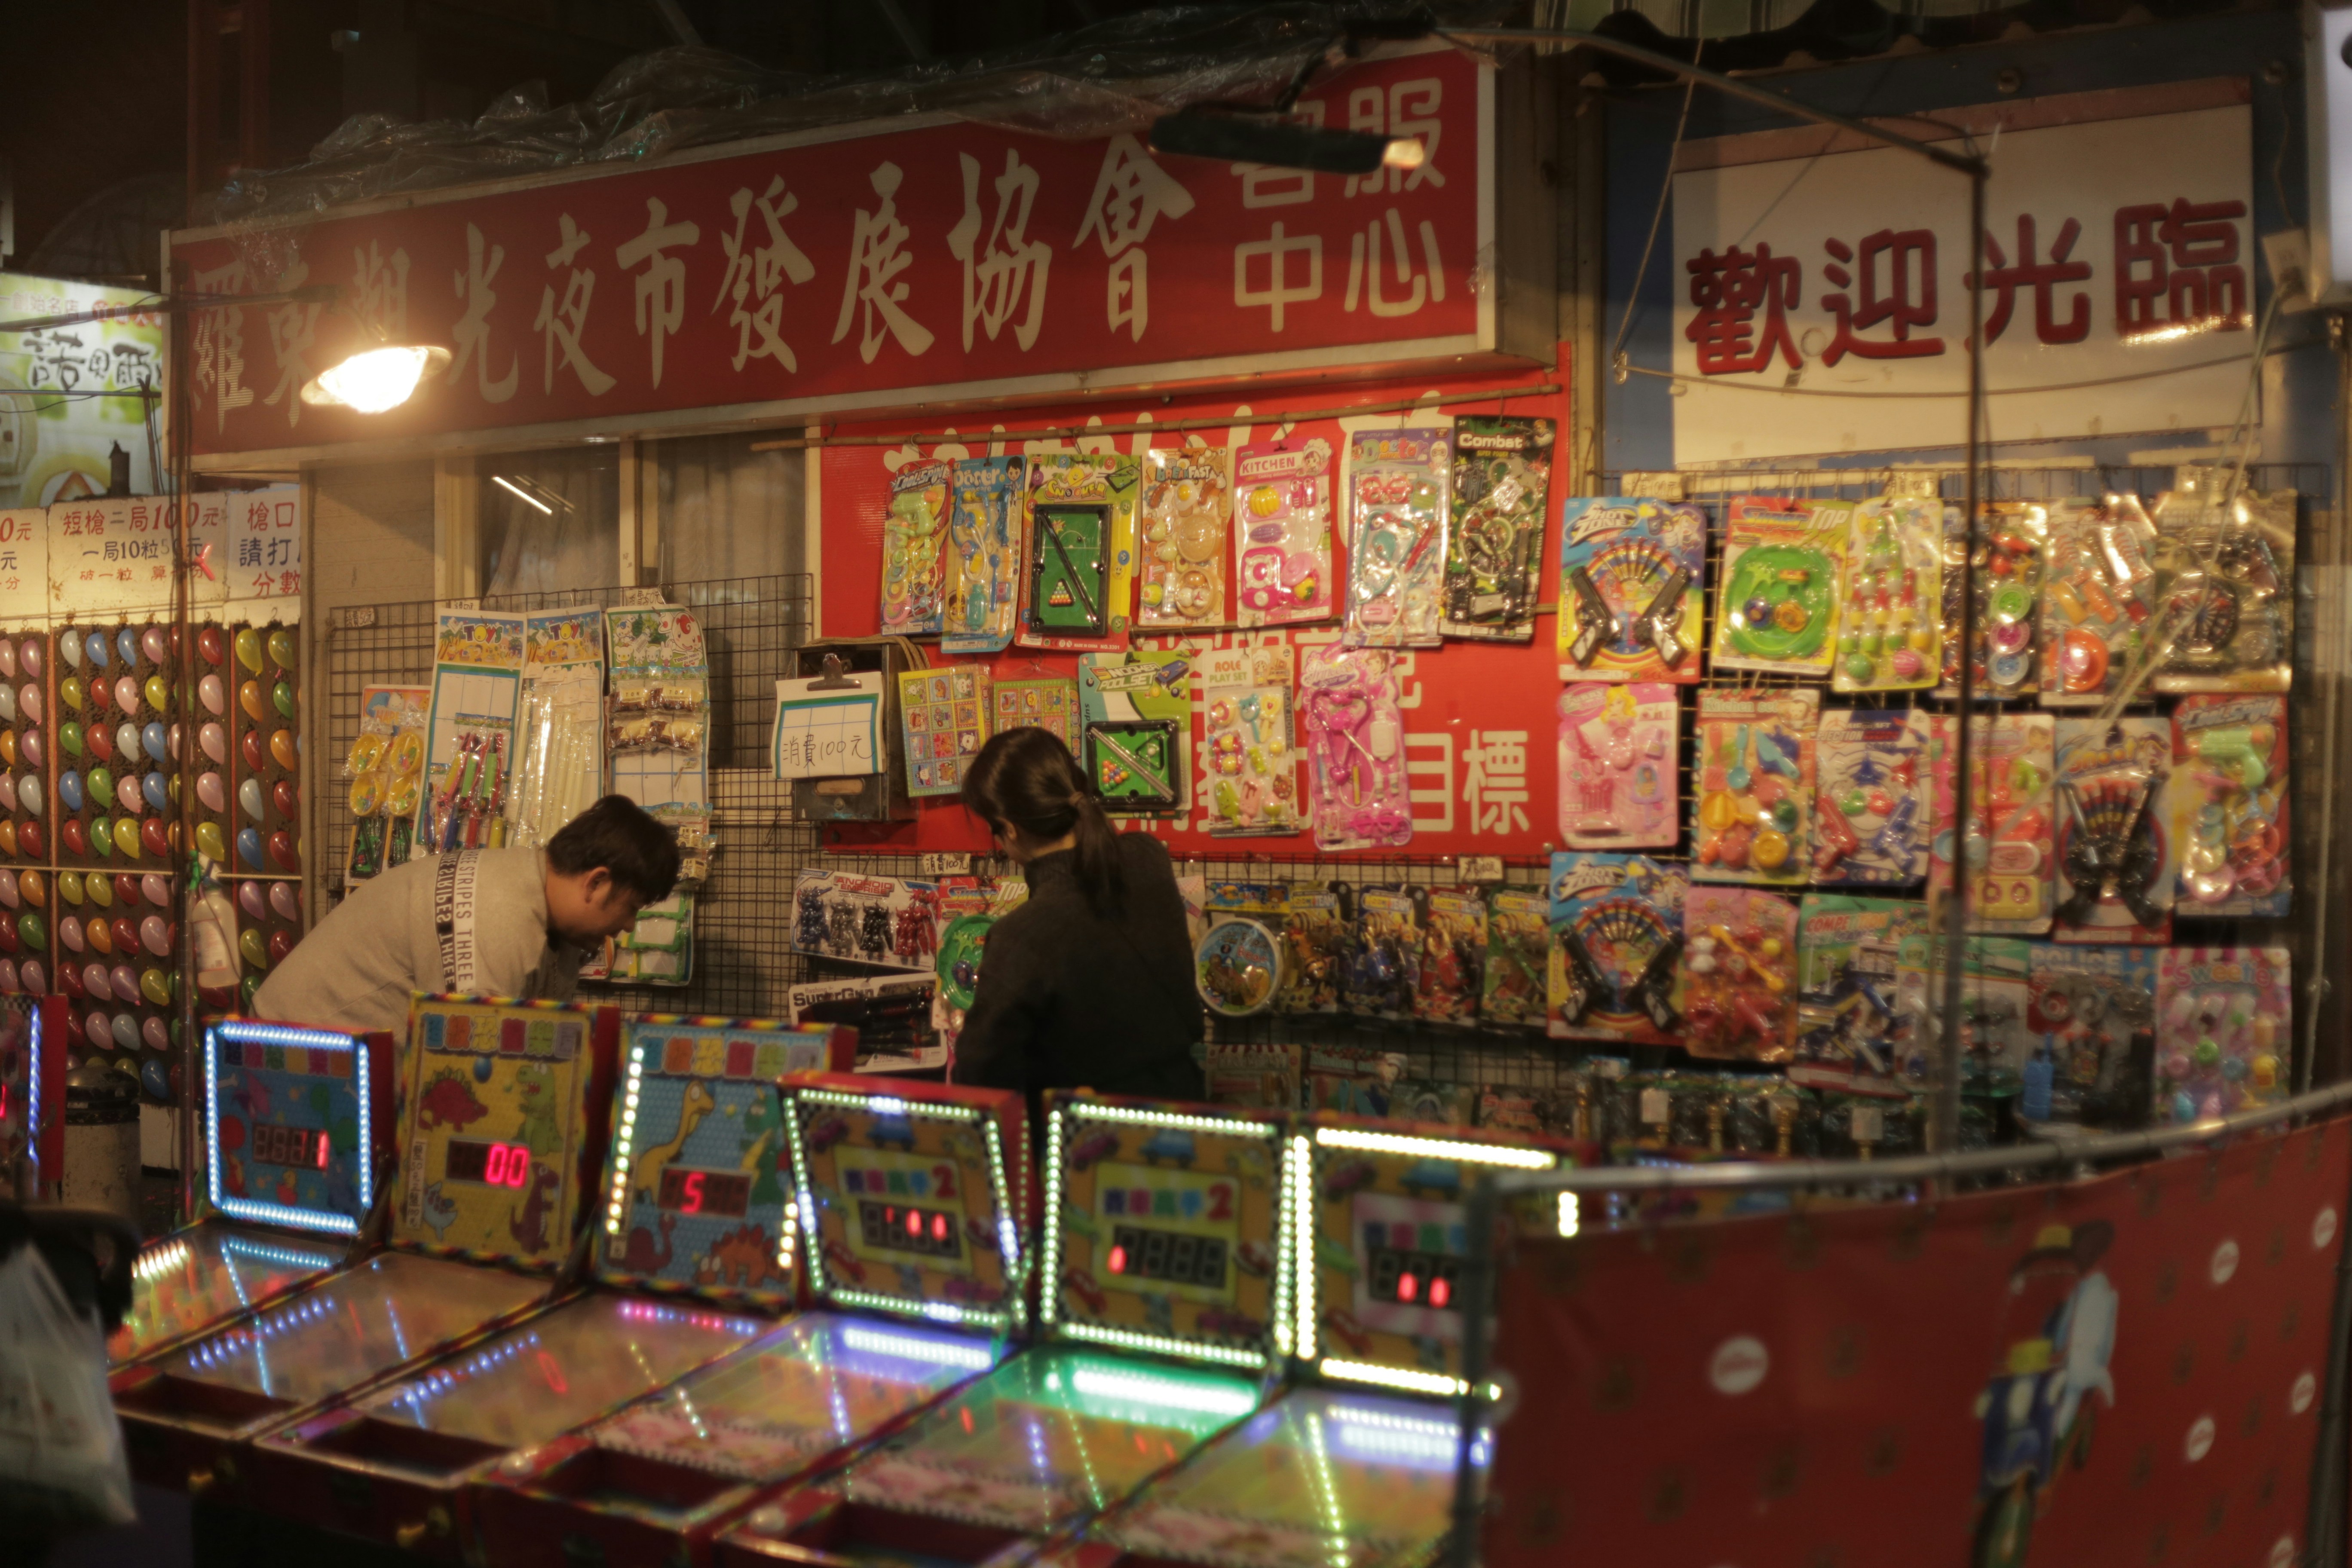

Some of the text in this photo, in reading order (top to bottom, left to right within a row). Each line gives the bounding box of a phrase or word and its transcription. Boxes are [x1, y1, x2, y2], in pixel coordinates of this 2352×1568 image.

[1234, 207, 1447, 334] 中心
[1684, 198, 2250, 377] 歡迎光臨
[23, 328, 162, 391] 諾貝爾
[1458, 433, 1524, 449] Combat
[1155, 466, 1211, 482] BREAKFAST
[1242, 456, 1295, 474] KITCHEN
[247, 501, 295, 532] 槍口
[1808, 506, 1850, 530] TOP
[239, 537, 300, 567] 請打
[462, 623, 504, 644] TOYS
[548, 619, 585, 642] TOYS
[1091, 664, 1161, 680] SNOOKER
[1214, 659, 1241, 673] ROLE
[1209, 671, 1247, 683] PLAY SET
[1702, 697, 1754, 712] Kitchen
[782, 733, 875, 769] 消費100元
[927, 854, 969, 873] 消費100元
[836, 876, 893, 889] ANDROID
[840, 884, 888, 895] EMPRISE
[995, 881, 1027, 902] TOP
[455, 850, 481, 982] HREE STRIPES THREE
[484, 1141, 529, 1189] 00
